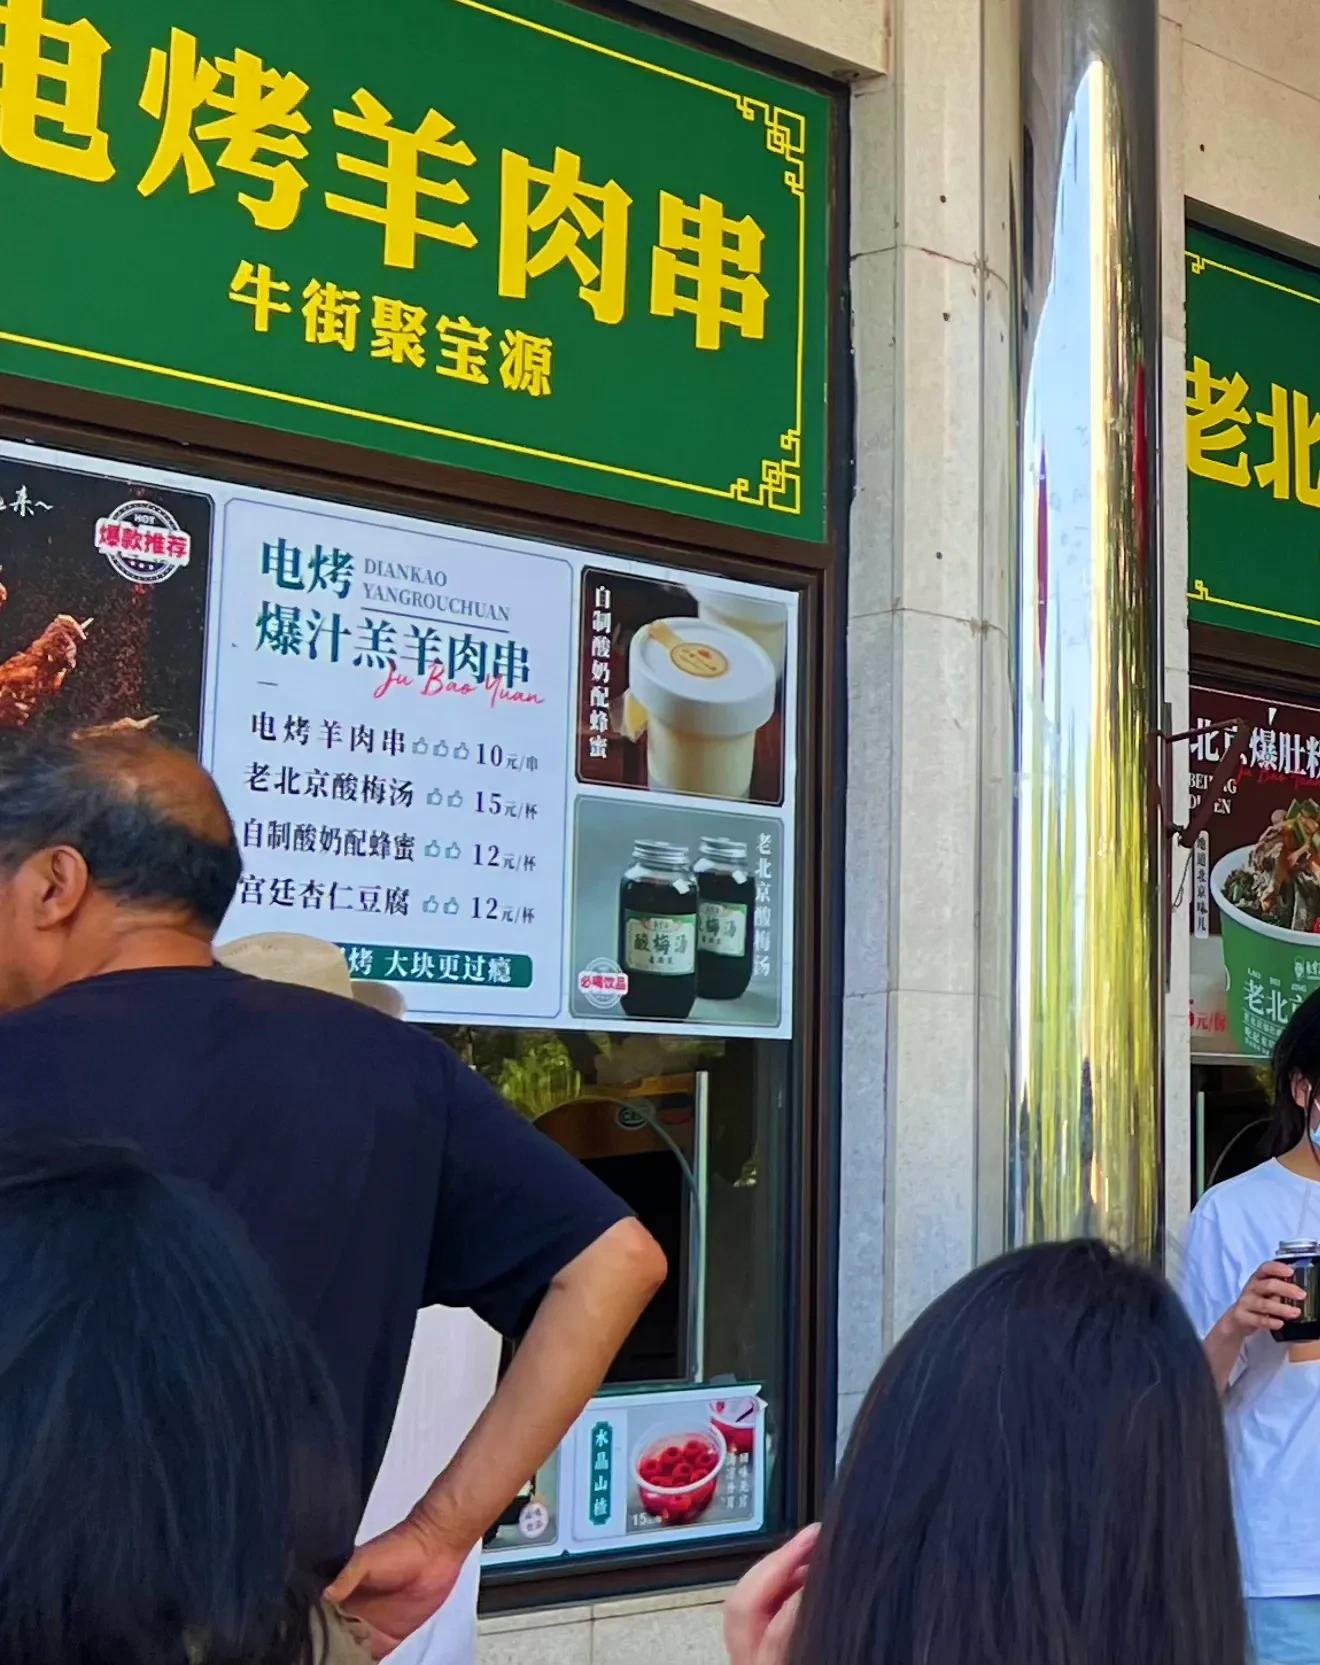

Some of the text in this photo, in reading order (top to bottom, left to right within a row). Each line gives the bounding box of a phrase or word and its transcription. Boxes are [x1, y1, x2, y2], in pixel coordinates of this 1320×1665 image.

[0, 0, 770, 350] 电烤羊肉串
[228, 259, 555, 398] 牛街聚宝源
[98, 523, 188, 560] 爆款推荐
[260, 536, 356, 600] 电烤
[363, 557, 448, 588] DIANKAO
[363, 581, 511, 623] YANGROUCHUAN
[255, 600, 530, 690] 爆汁羔羊肉串
[372, 660, 414, 700] Ju
[421, 665, 476, 698] Bao
[588, 585, 612, 760] 自制酸奶配蜂蜜
[251, 711, 406, 757] 电烤羊肉串
[243, 761, 538, 821] 老北京酸梅汤 15元/杯
[243, 818, 537, 874] 自制酸奶配蜂蜜 12元/杯
[237, 874, 535, 926] 宫廷杏仁豆腐 12元/杯
[384, 951, 513, 984] 大块更过瘾
